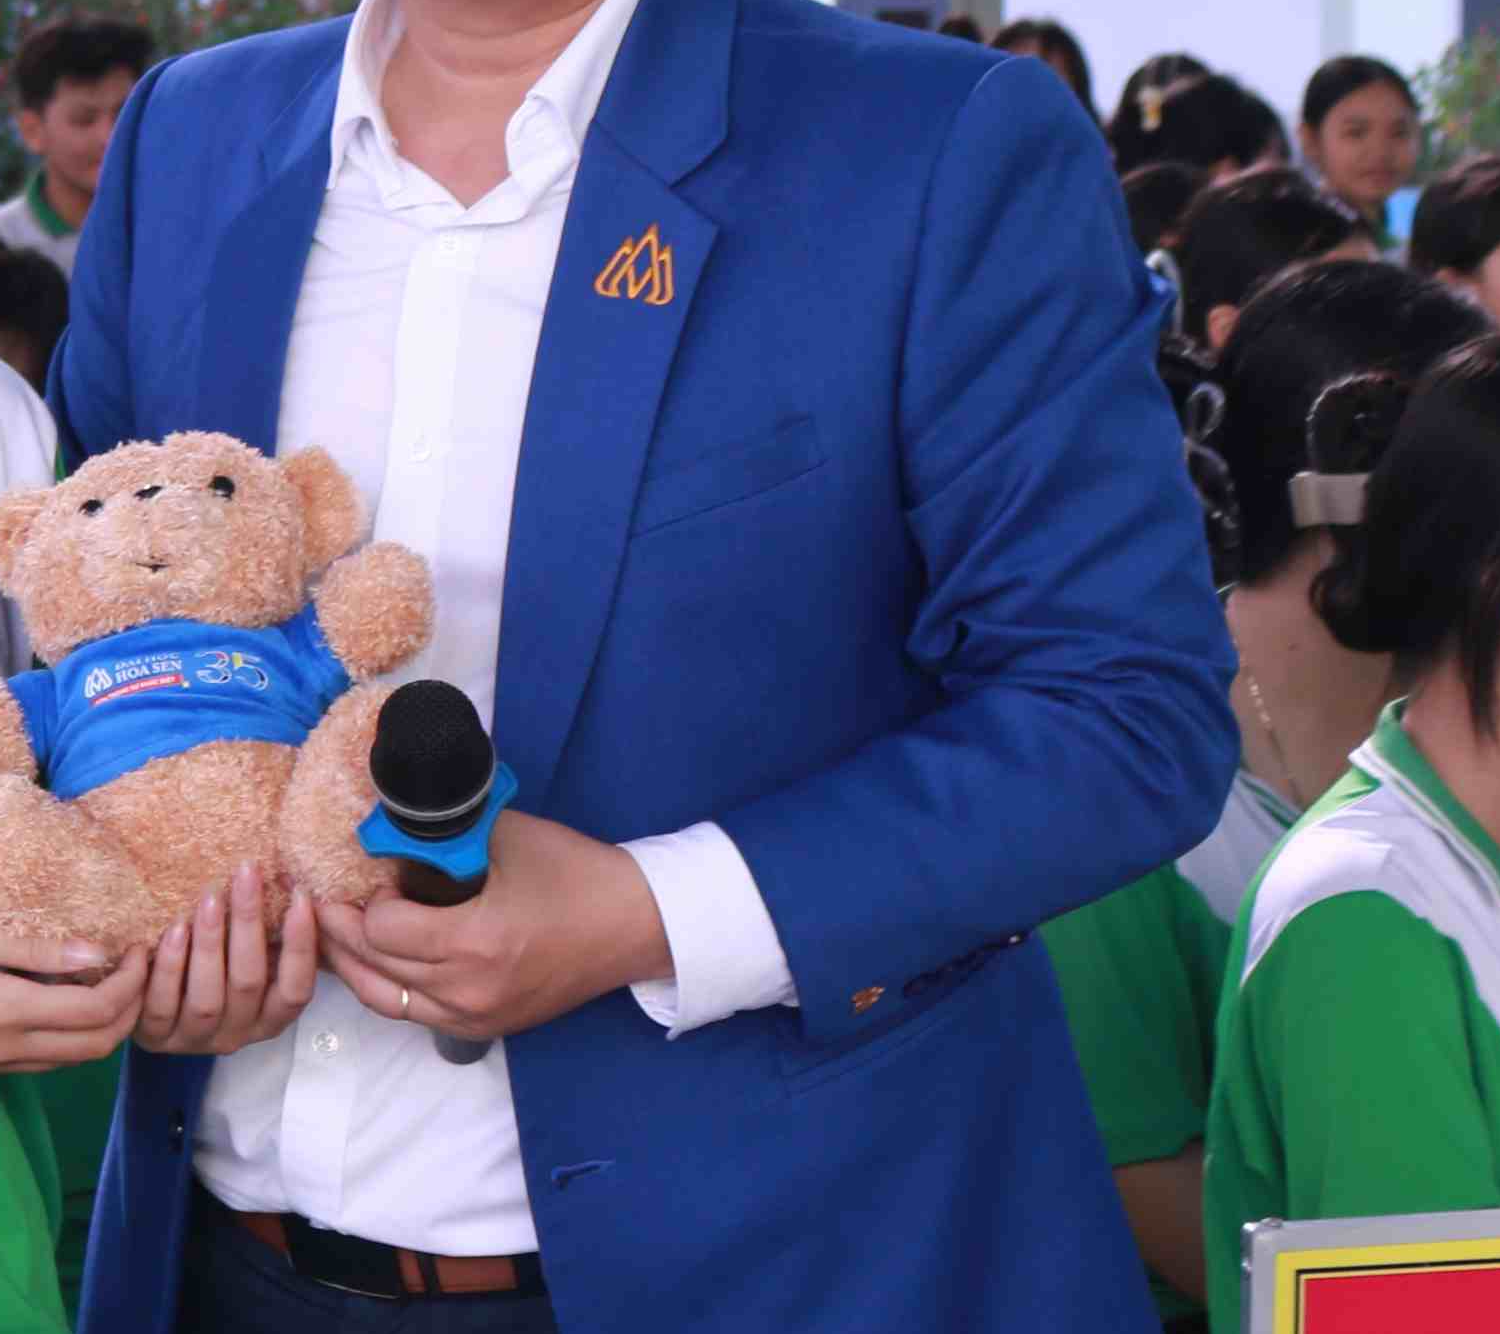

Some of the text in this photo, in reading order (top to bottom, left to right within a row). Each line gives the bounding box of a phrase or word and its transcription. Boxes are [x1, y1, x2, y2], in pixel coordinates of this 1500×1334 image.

[115, 660, 184, 684] HOA SEN
[194, 650, 269, 692] 35
